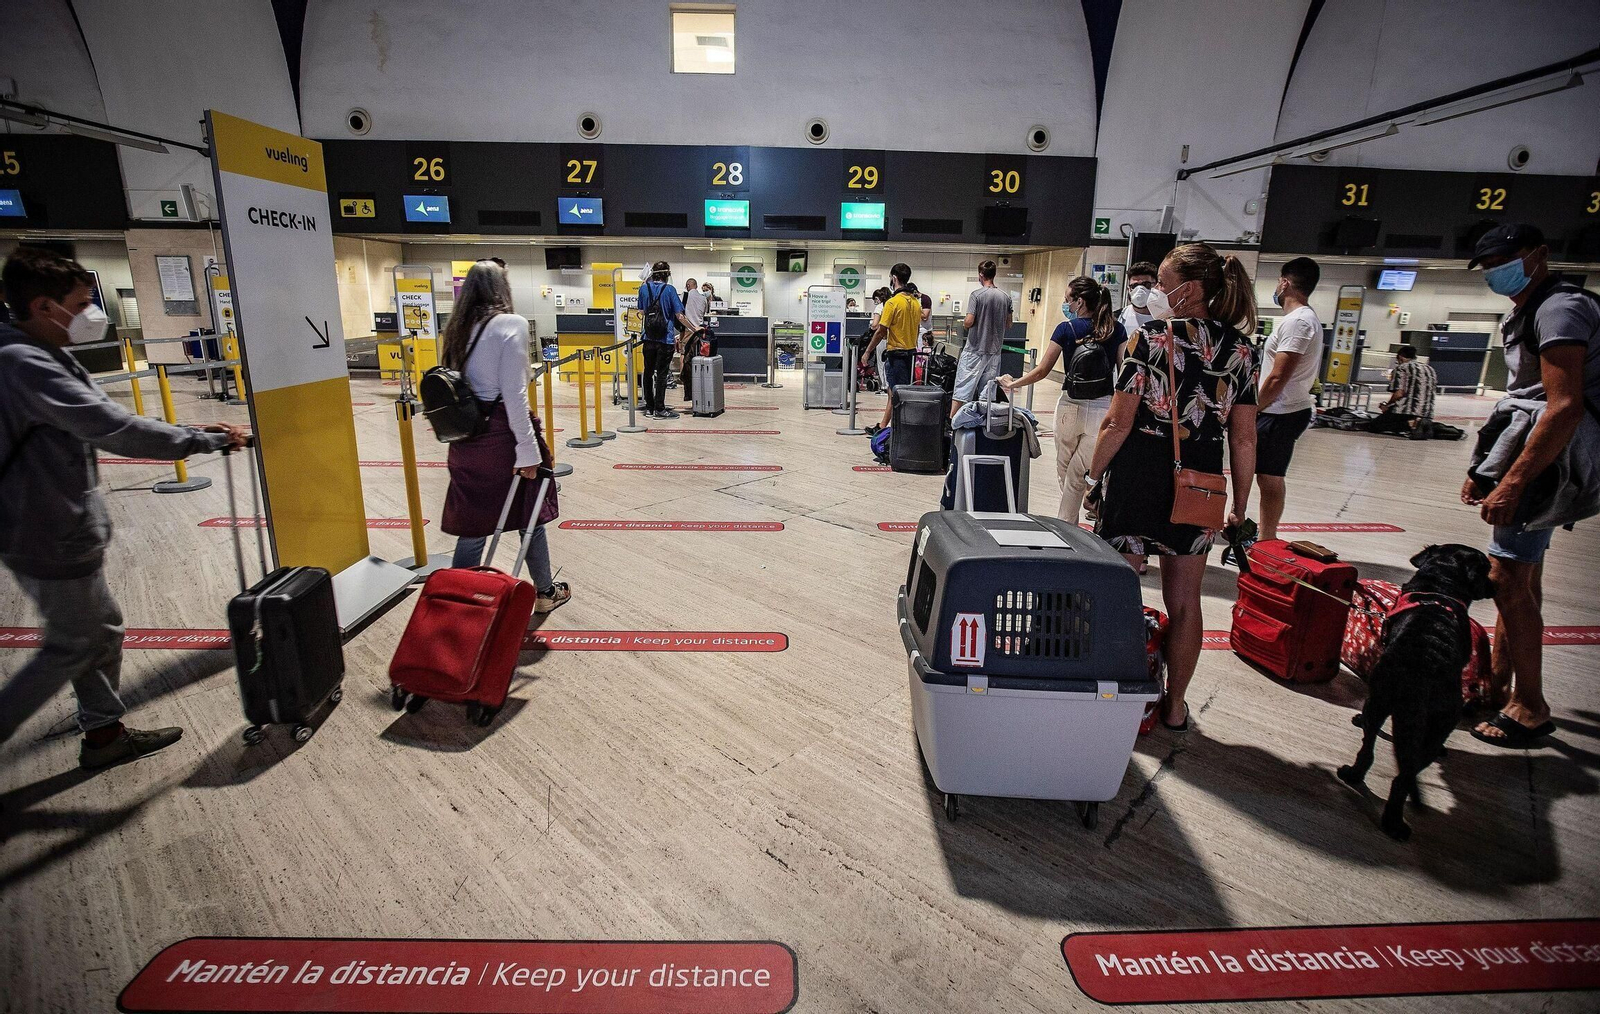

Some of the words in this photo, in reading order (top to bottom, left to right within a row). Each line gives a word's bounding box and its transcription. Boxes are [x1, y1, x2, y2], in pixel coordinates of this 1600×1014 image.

[0, 151, 20, 175] 5
[265, 147, 308, 173] vueling
[413, 157, 445, 181] 26
[567, 159, 597, 183] 27
[712, 162, 743, 185] 28
[848, 165, 878, 189] 29
[989, 169, 1020, 193] 30
[1342, 183, 1369, 206] 31
[1476, 188, 1507, 210] 32
[247, 207, 317, 232] CHECK-IN
[177, 634, 232, 643] distanc
[551, 635, 621, 644] distancia
[633, 636, 670, 645] Keep
[674, 637, 709, 646] your
[712, 636, 775, 646] distance
[1095, 951, 1211, 977] Mantén
[1208, 950, 1245, 973] la
[1246, 946, 1380, 973] distancia
[1386, 945, 1464, 972] Keep
[1462, 946, 1530, 971] your
[165, 958, 290, 983] Mantén
[292, 960, 325, 984] la
[329, 960, 471, 986] distancia
[492, 962, 566, 992] Keep
[571, 966, 641, 993] your
[649, 963, 771, 988] distance
